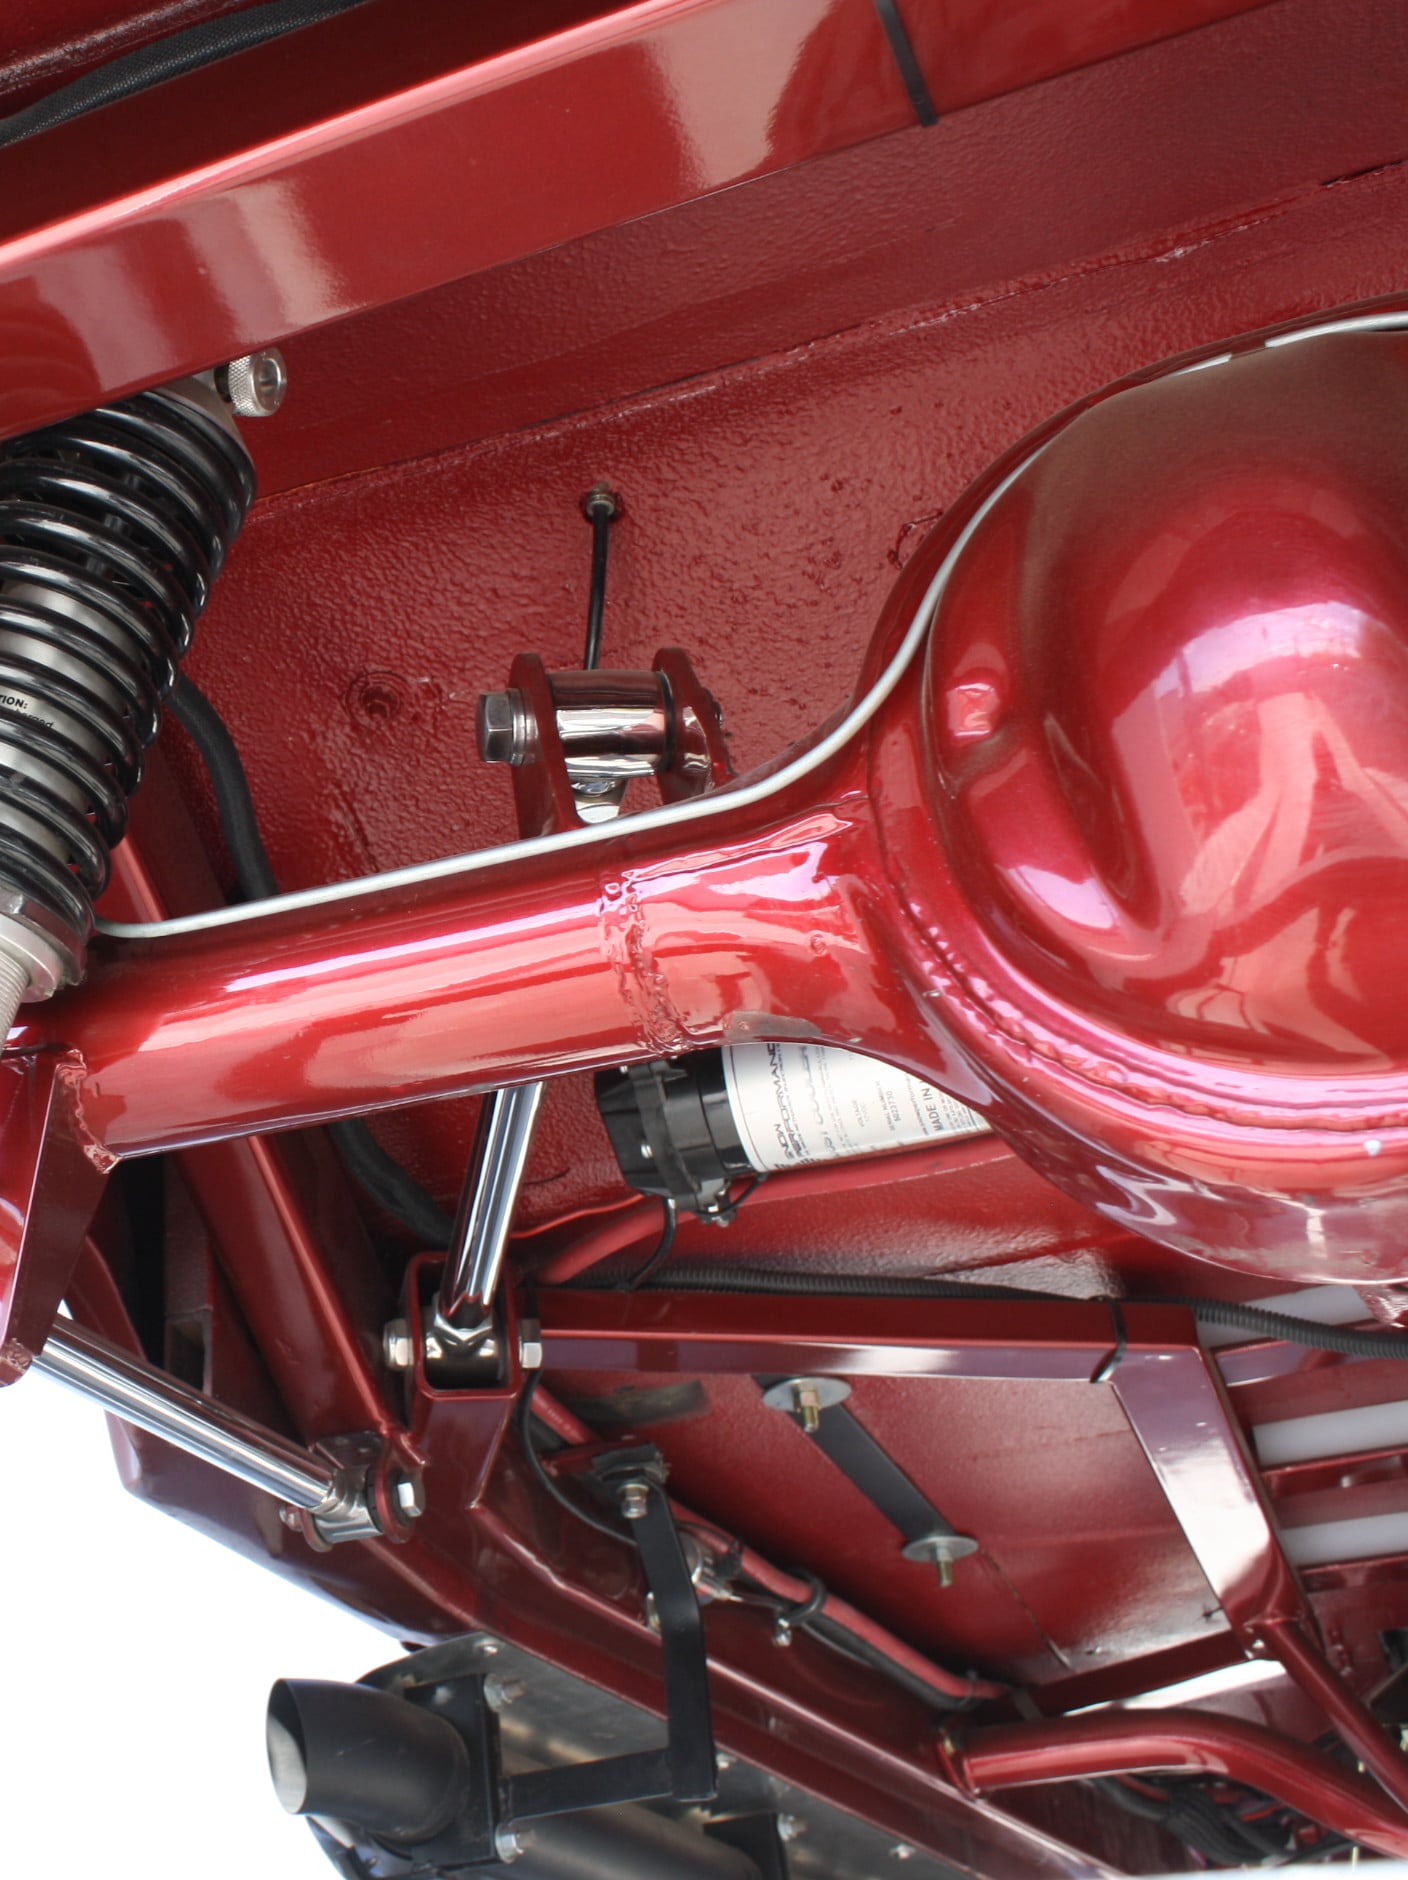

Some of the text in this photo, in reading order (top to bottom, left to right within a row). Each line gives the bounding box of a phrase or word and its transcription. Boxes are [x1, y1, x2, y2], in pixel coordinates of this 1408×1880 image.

[767, 1043, 803, 1158] PERFORMANC
[921, 1087, 945, 1131] MADE IN
